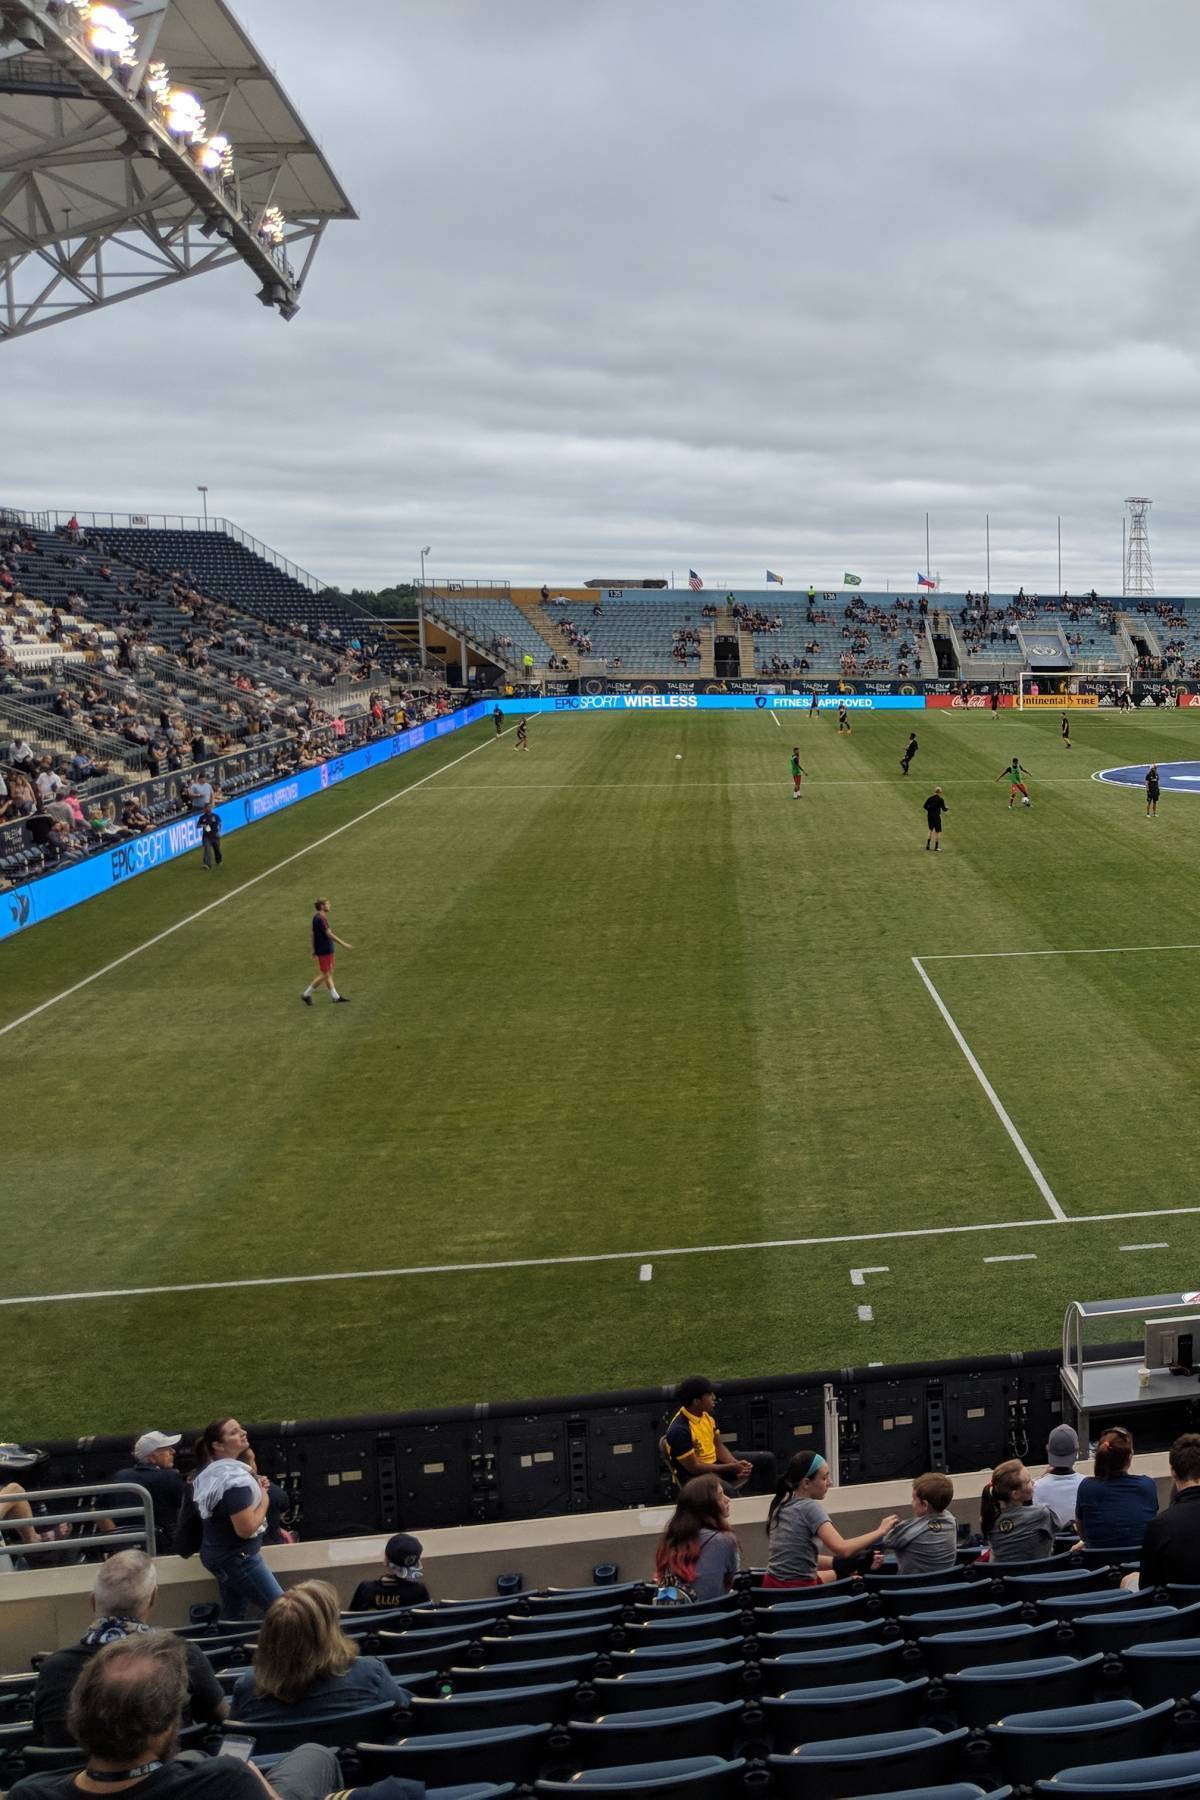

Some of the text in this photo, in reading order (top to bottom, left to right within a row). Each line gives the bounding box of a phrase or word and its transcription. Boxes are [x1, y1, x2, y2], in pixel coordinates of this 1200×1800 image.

[624, 695, 698, 708] WIRELESS
[169, 816, 204, 854] WIREL
[375, 1594, 401, 1606] ELLIS
